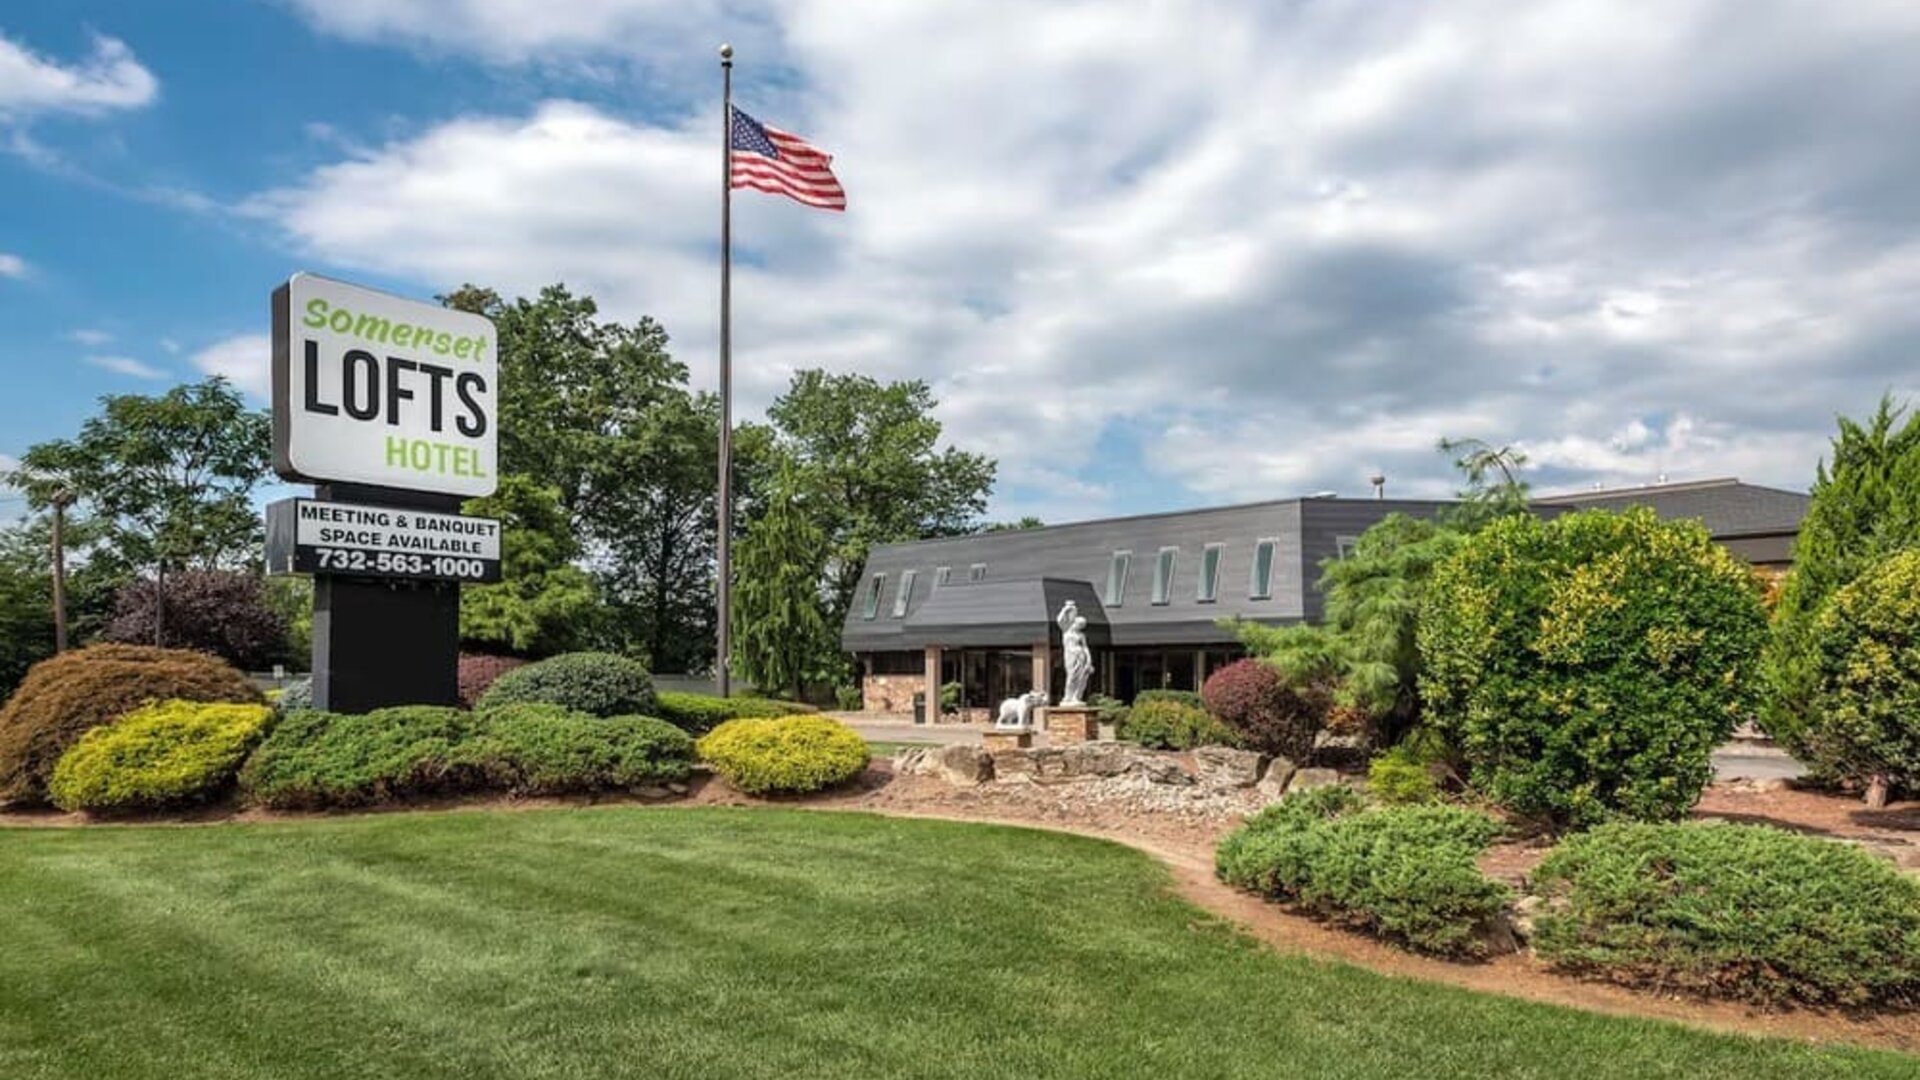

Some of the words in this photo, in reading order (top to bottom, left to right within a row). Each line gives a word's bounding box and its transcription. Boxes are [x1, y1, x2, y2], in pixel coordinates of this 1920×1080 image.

[302, 298, 488, 362] Somerset
[304, 339, 487, 438] LOFTS
[385, 436, 487, 478] HOTEL
[301, 505, 390, 527] MEETING
[396, 515, 409, 528] &
[415, 517, 497, 537] BANQUET
[319, 528, 382, 546] SPACE
[387, 533, 482, 554] AVAILABLE
[315, 549, 484, 577] 732-563-1000
